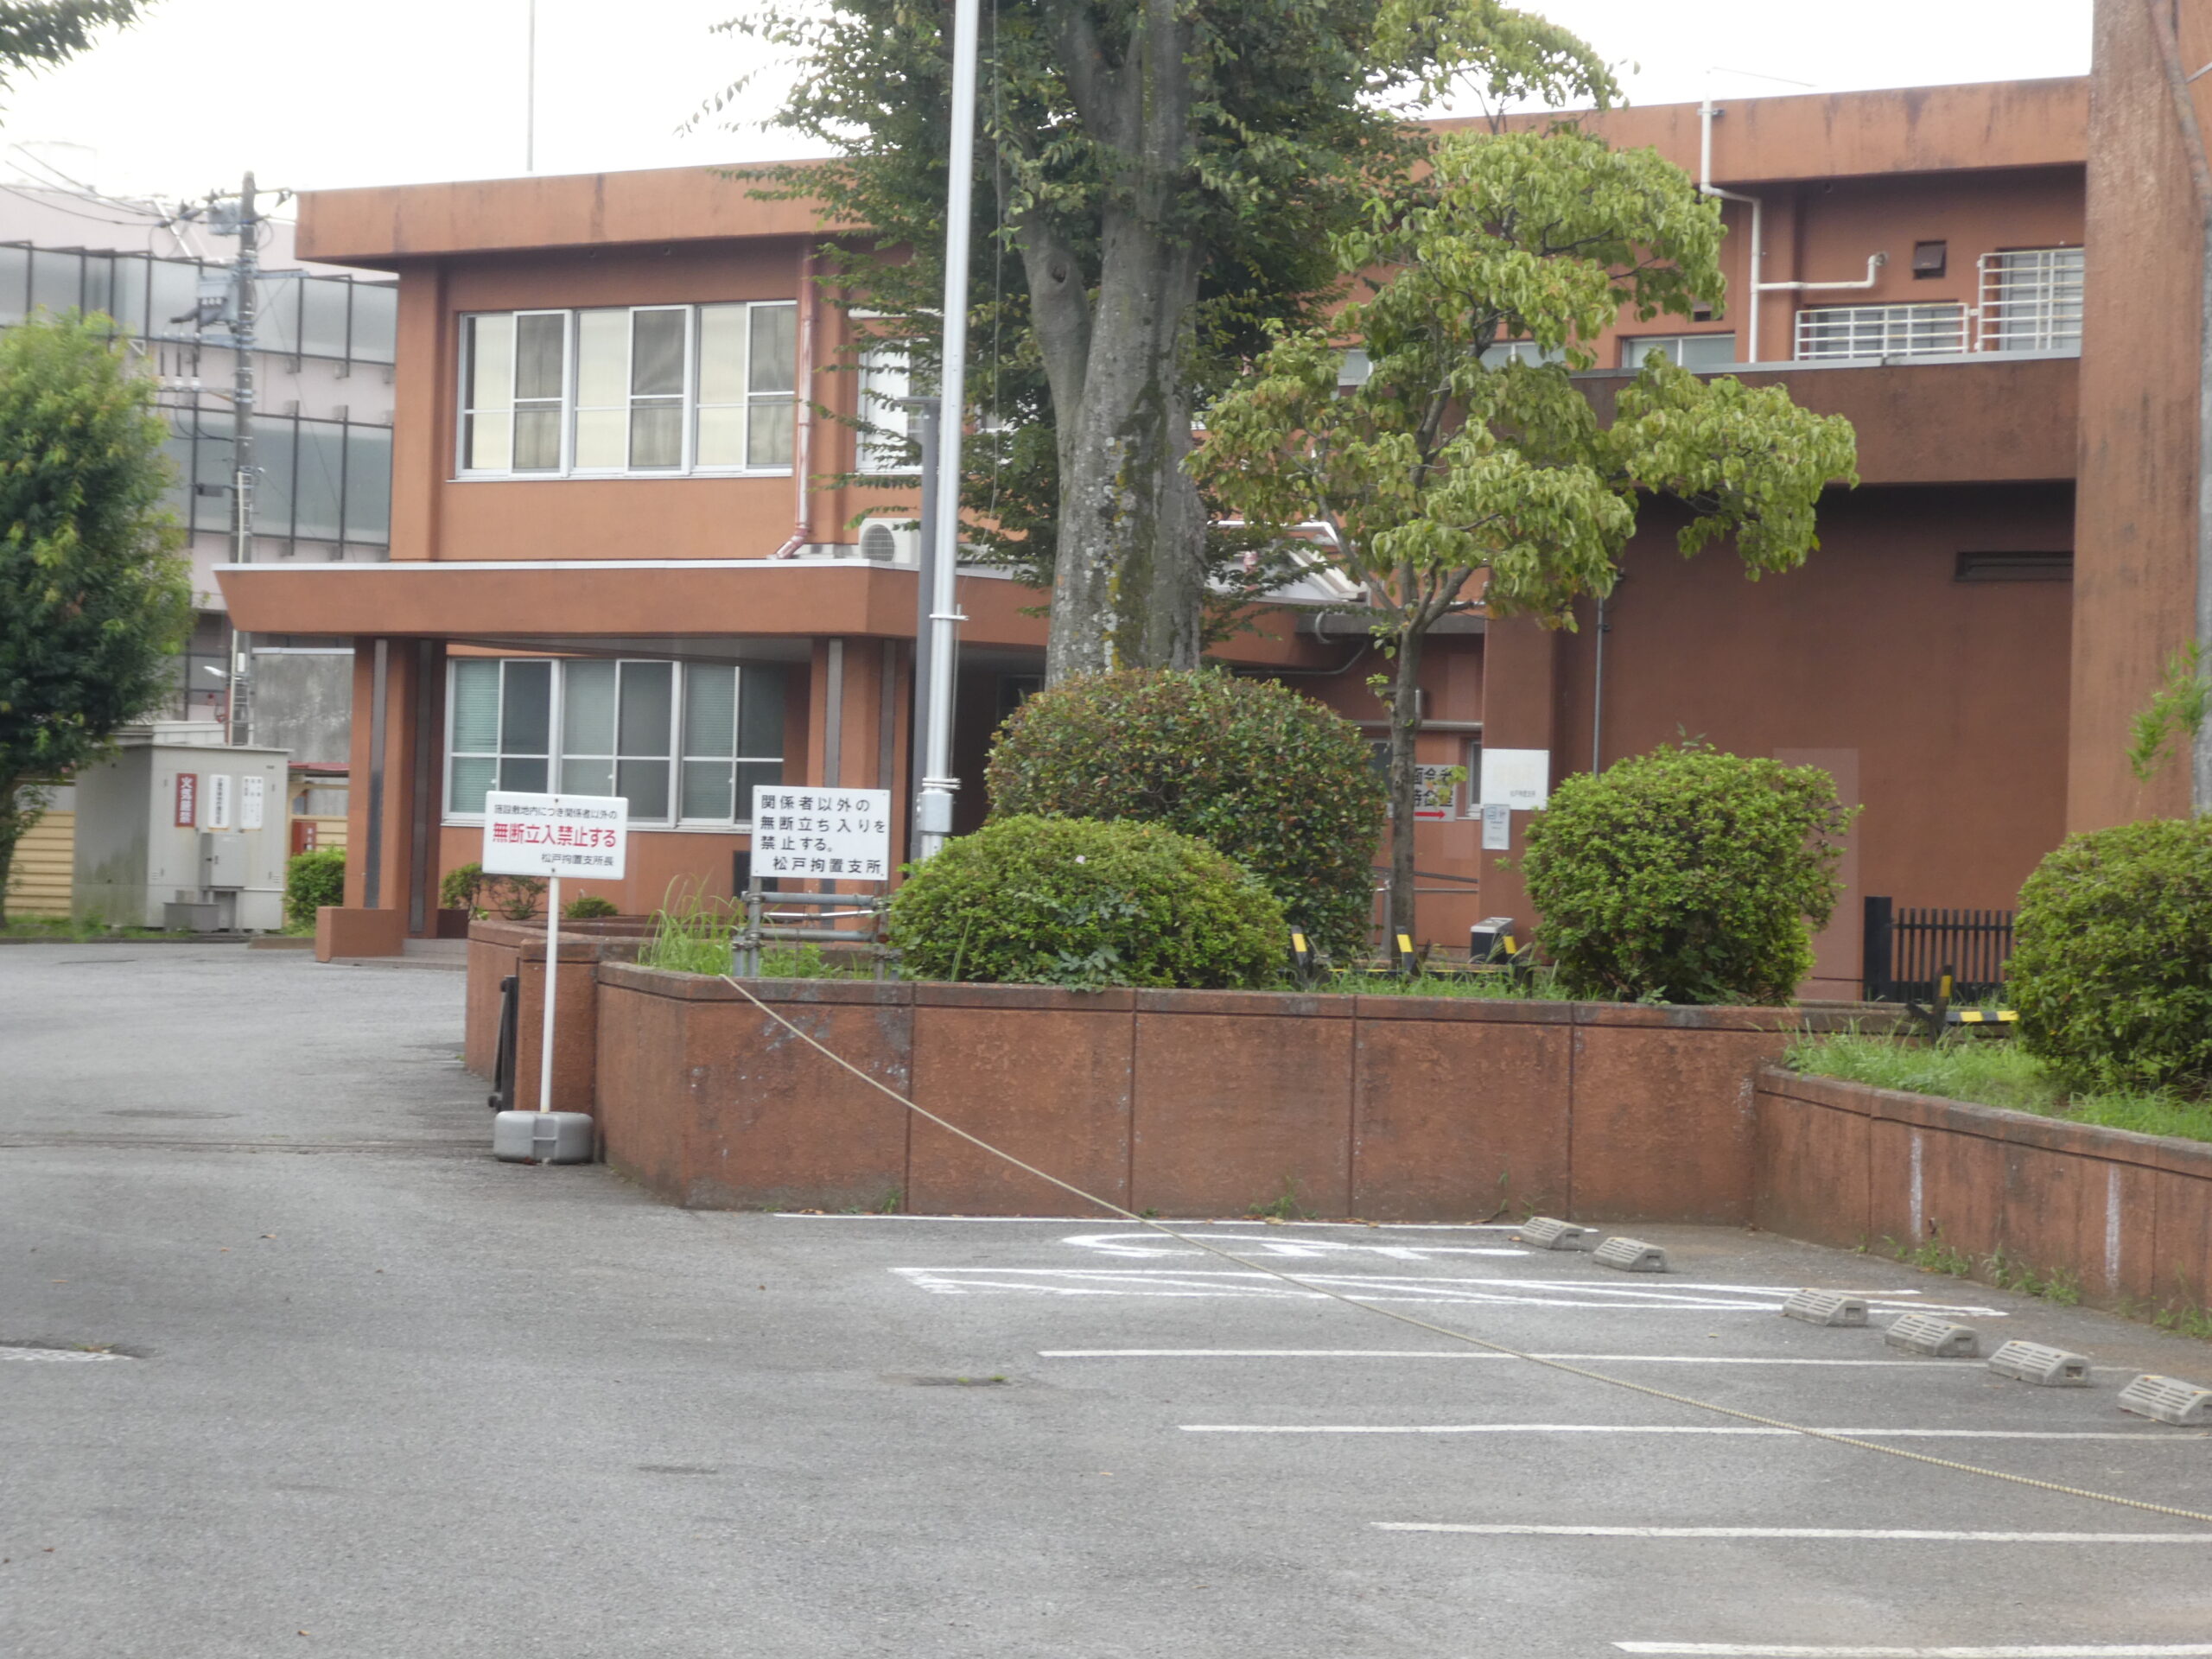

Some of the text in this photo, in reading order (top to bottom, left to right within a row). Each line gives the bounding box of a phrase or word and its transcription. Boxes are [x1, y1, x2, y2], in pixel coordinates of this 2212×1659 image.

[760, 794, 870, 812] 関係者以外の
[760, 816, 886, 834] 無断立ち入りを
[493, 822, 617, 848] 無断立入禁止する
[760, 836, 833, 853] 禁止する。
[541, 853, 614, 867] 松戸拘置支所長
[772, 855, 881, 874] 松戸拘置支所
